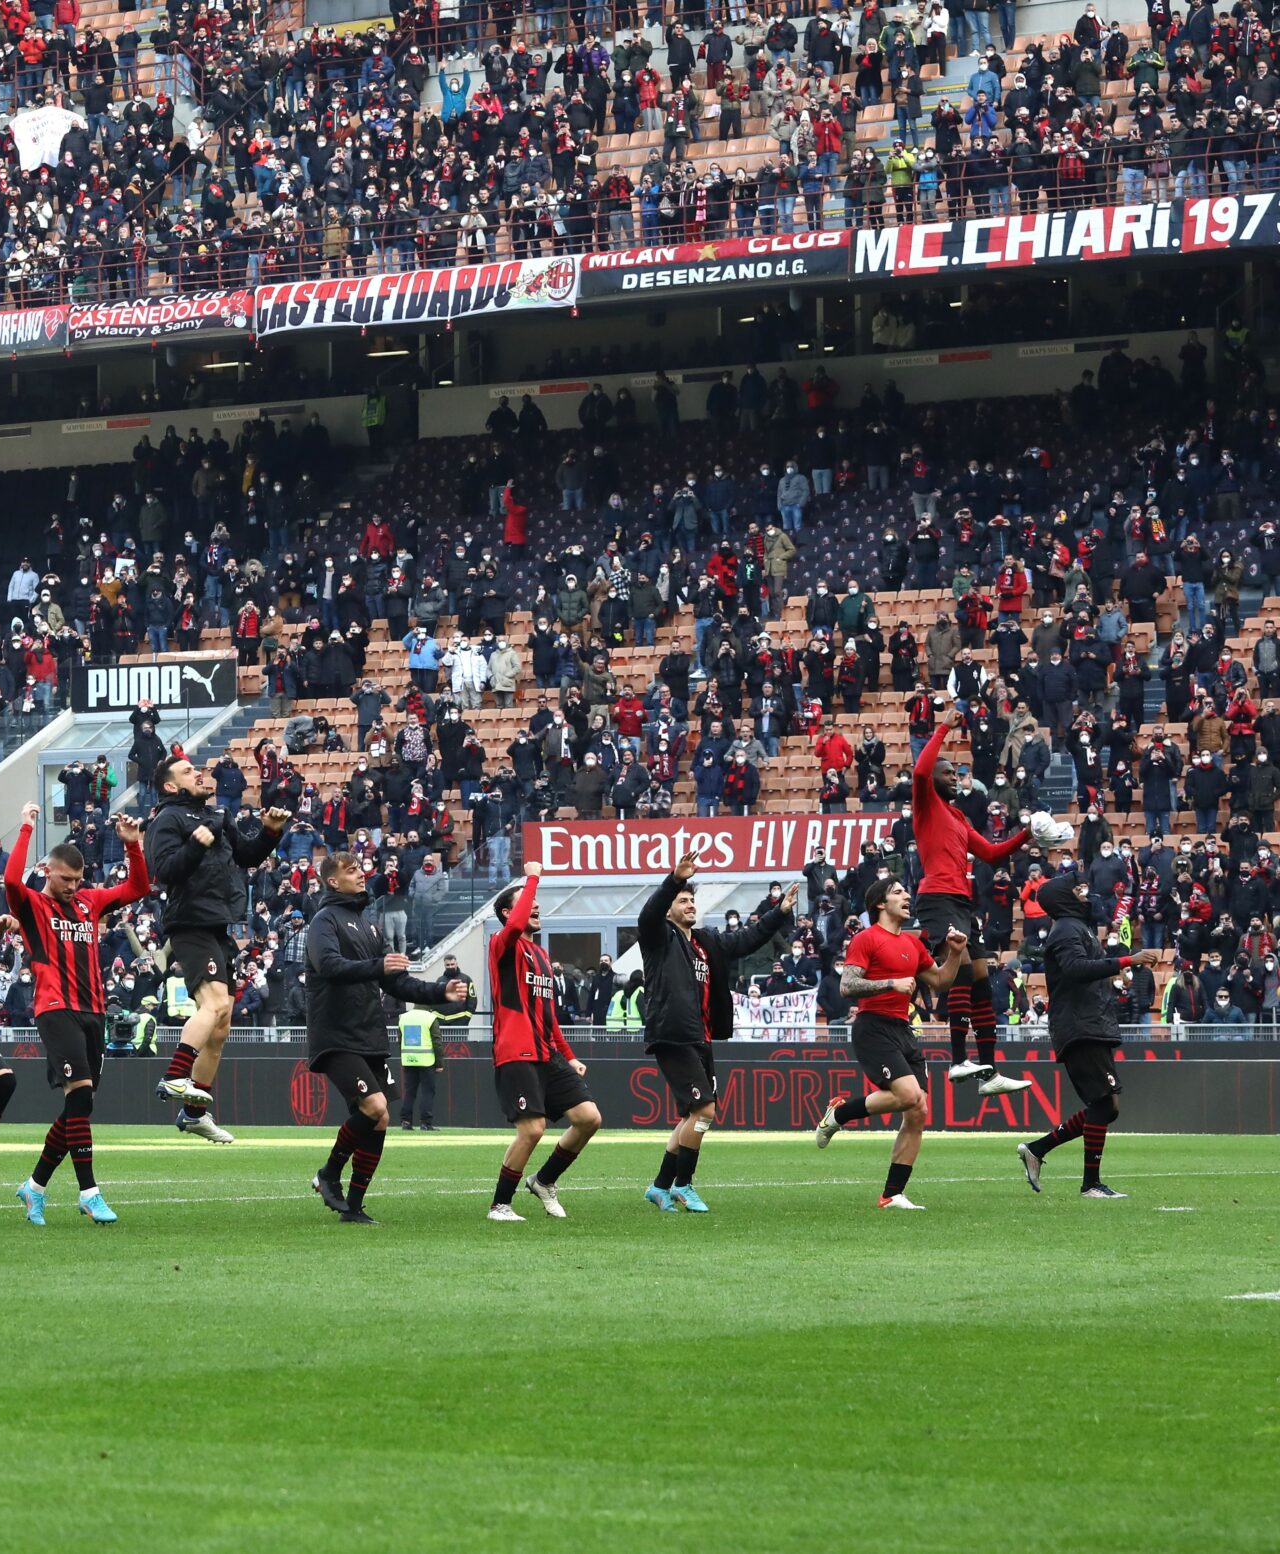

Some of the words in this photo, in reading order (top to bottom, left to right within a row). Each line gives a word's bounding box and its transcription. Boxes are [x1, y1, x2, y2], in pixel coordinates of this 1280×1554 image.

[589, 247, 679, 268] MILAN
[747, 232, 841, 253] CLUB
[621, 261, 771, 290] DESENZANO
[70, 297, 152, 312] MILAN
[159, 289, 228, 304] CLUB
[256, 261, 523, 333] CASTELFIDARDO
[68, 300, 221, 330] CASTENEDOLO
[74, 328, 91, 339] by
[95, 325, 147, 337] Maury
[150, 325, 162, 335] &
[164, 318, 204, 332] Samy
[88, 665, 181, 707] PUMA
[539, 823, 734, 871] Emirates
[748, 820, 798, 868] FLY
[804, 817, 900, 866] BETTE
[526, 971, 554, 988] Emira
[630, 1066, 858, 1127] SMPRE
